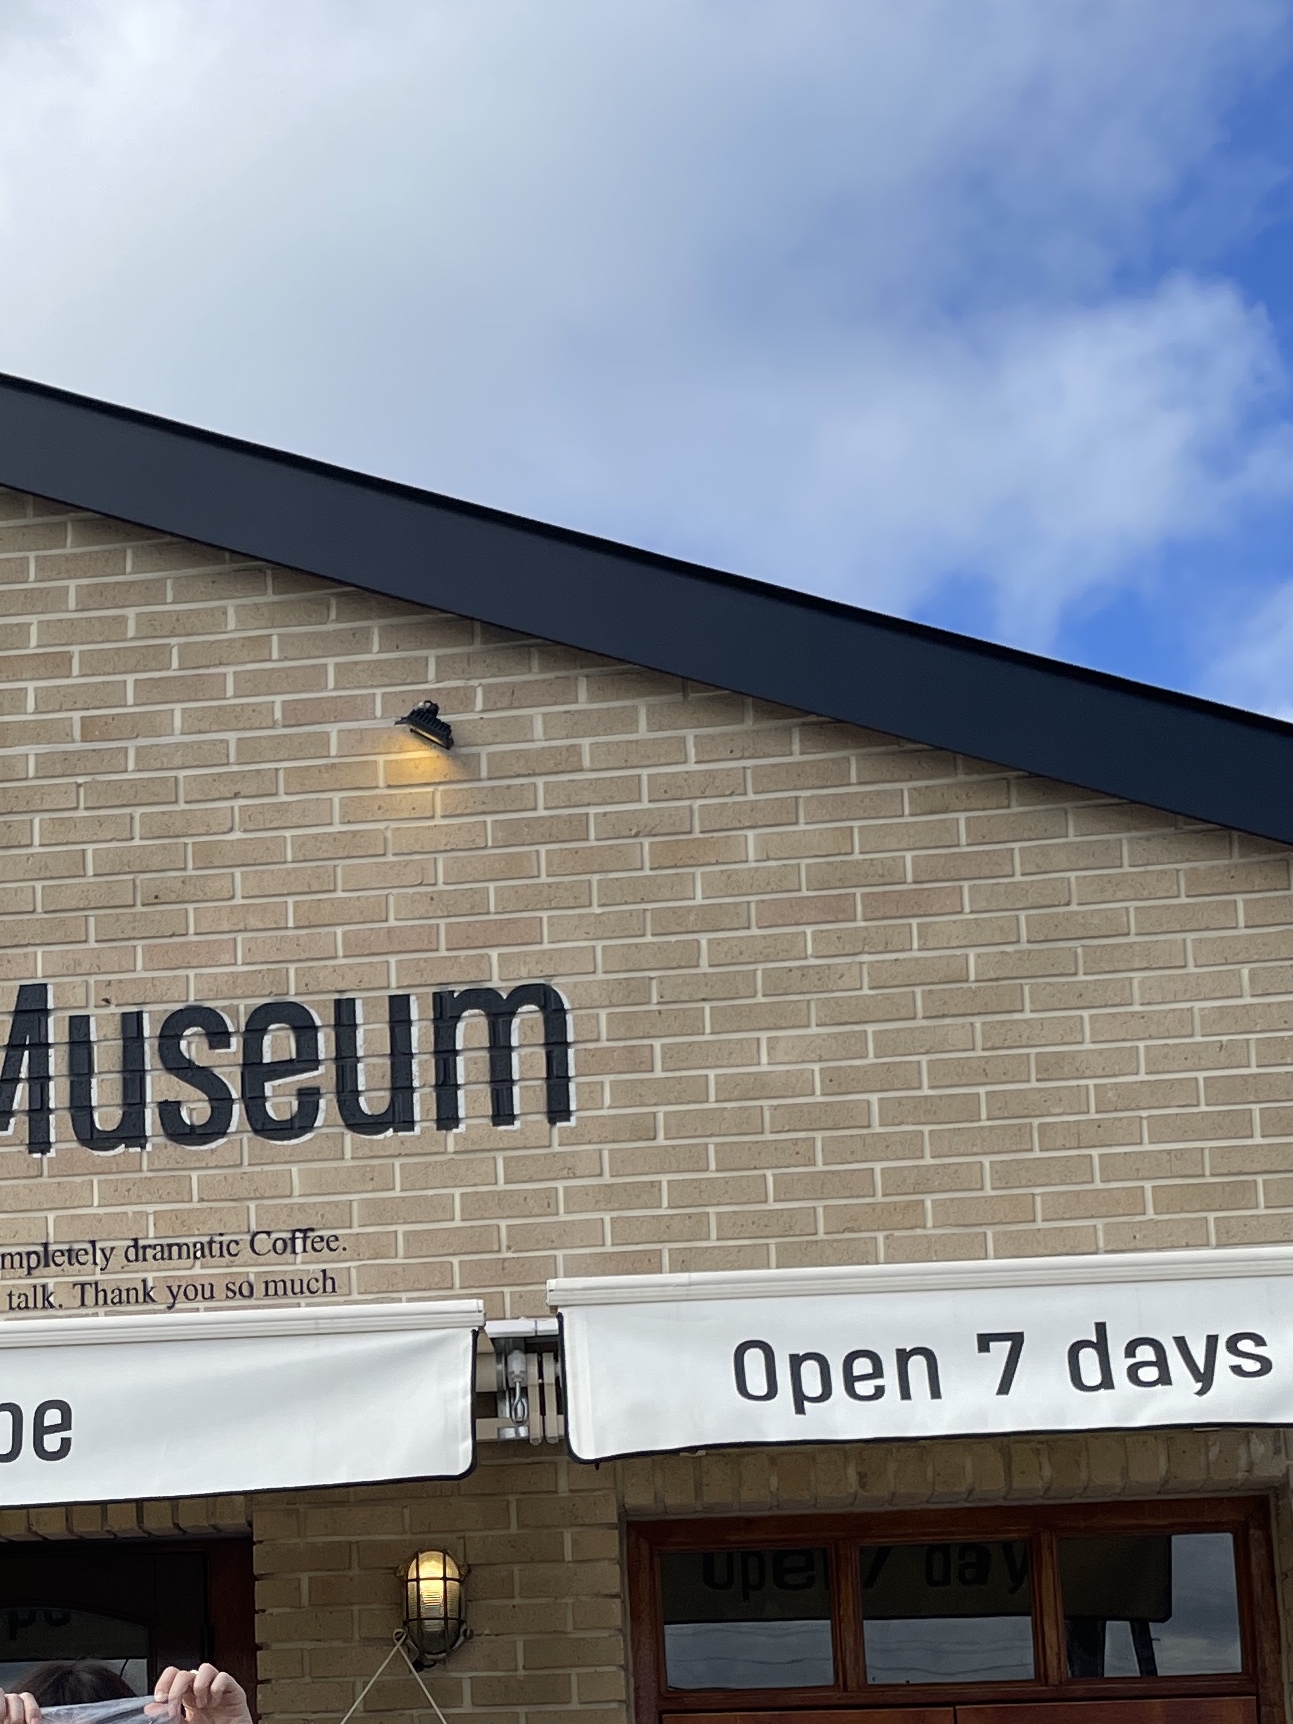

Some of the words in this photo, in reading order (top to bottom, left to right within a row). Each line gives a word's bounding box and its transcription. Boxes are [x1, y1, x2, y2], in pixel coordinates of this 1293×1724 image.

[124, 1232, 240, 1264] dramatic
[249, 1227, 348, 1257] Coffee.
[6, 1283, 63, 1312] talk.
[73, 1279, 157, 1308] Thank
[166, 1283, 215, 1310] you
[225, 1279, 255, 1300] so
[262, 1269, 337, 1298] much
[732, 1339, 942, 1415] Open
[976, 1331, 1025, 1396] 7
[1067, 1321, 1273, 1397] days
